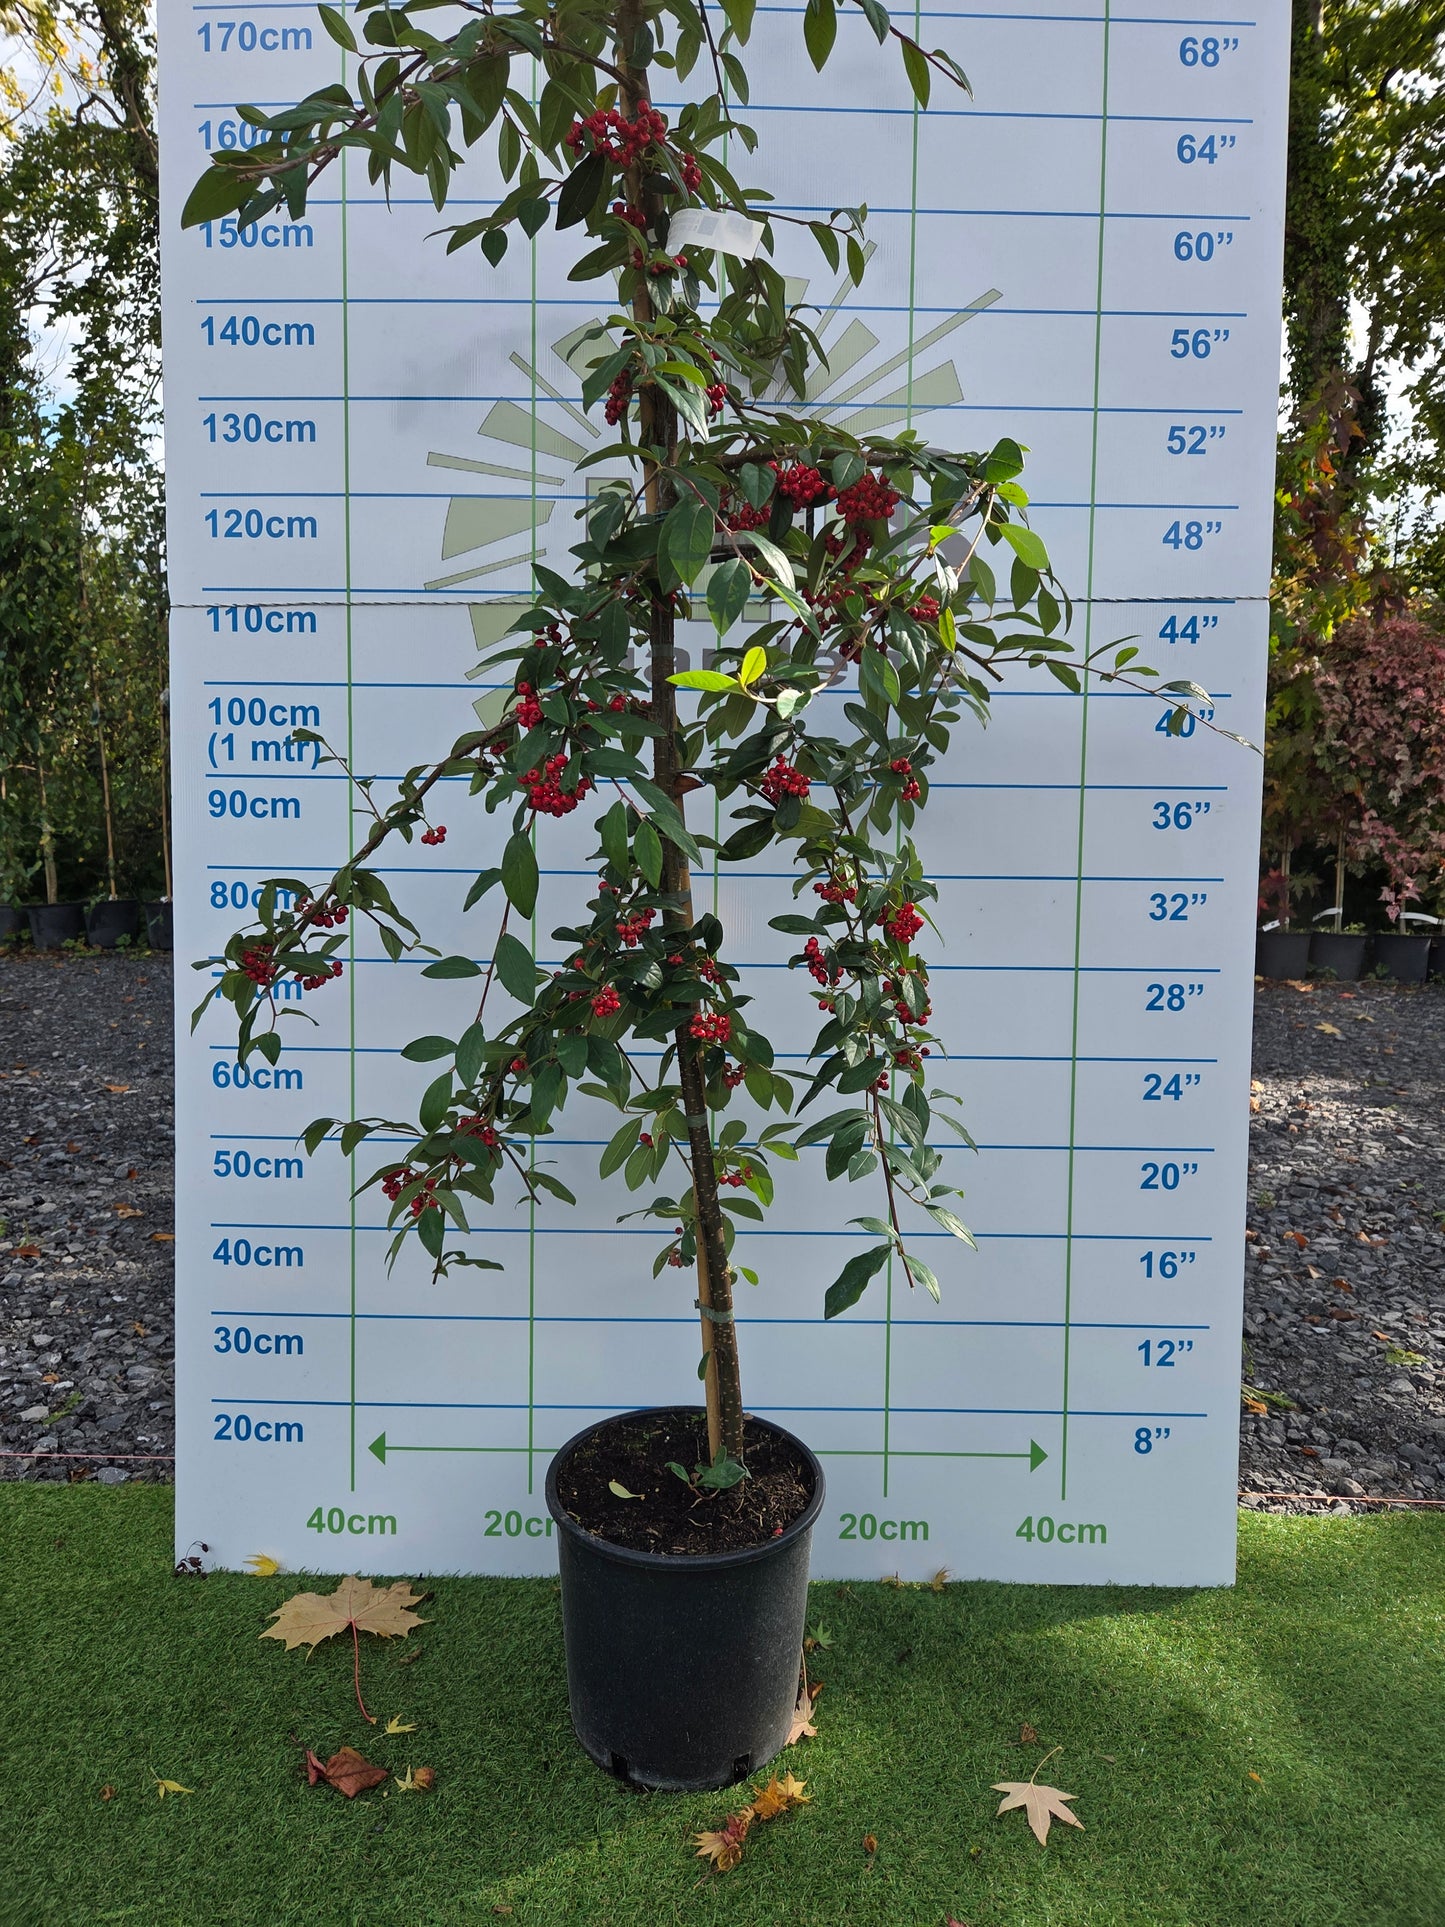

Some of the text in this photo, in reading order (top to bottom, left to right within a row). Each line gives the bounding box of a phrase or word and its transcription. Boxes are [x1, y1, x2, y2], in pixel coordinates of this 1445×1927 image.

[197, 21, 312, 52] 170cm
[198, 119, 312, 150] 160
[199, 218, 313, 248] 150cm
[201, 315, 315, 346] 140cm
[203, 412, 316, 443] 130cm
[204, 508, 317, 539] 120cm
[206, 604, 317, 634] 110cm
[208, 696, 320, 727] 100cm
[207, 732, 321, 770] (1 mtr)
[208, 789, 301, 819] 90cm
[212, 1060, 303, 1090] 60cm
[213, 1150, 304, 1179] 50cm
[212, 1238, 304, 1267] 40cm
[213, 1326, 304, 1355] 30cm
[213, 1413, 304, 1443] 20cm
[306, 1507, 397, 1535] 40cm
[839, 1513, 929, 1541] 20cm
[1015, 1516, 1107, 1544] 40cm
